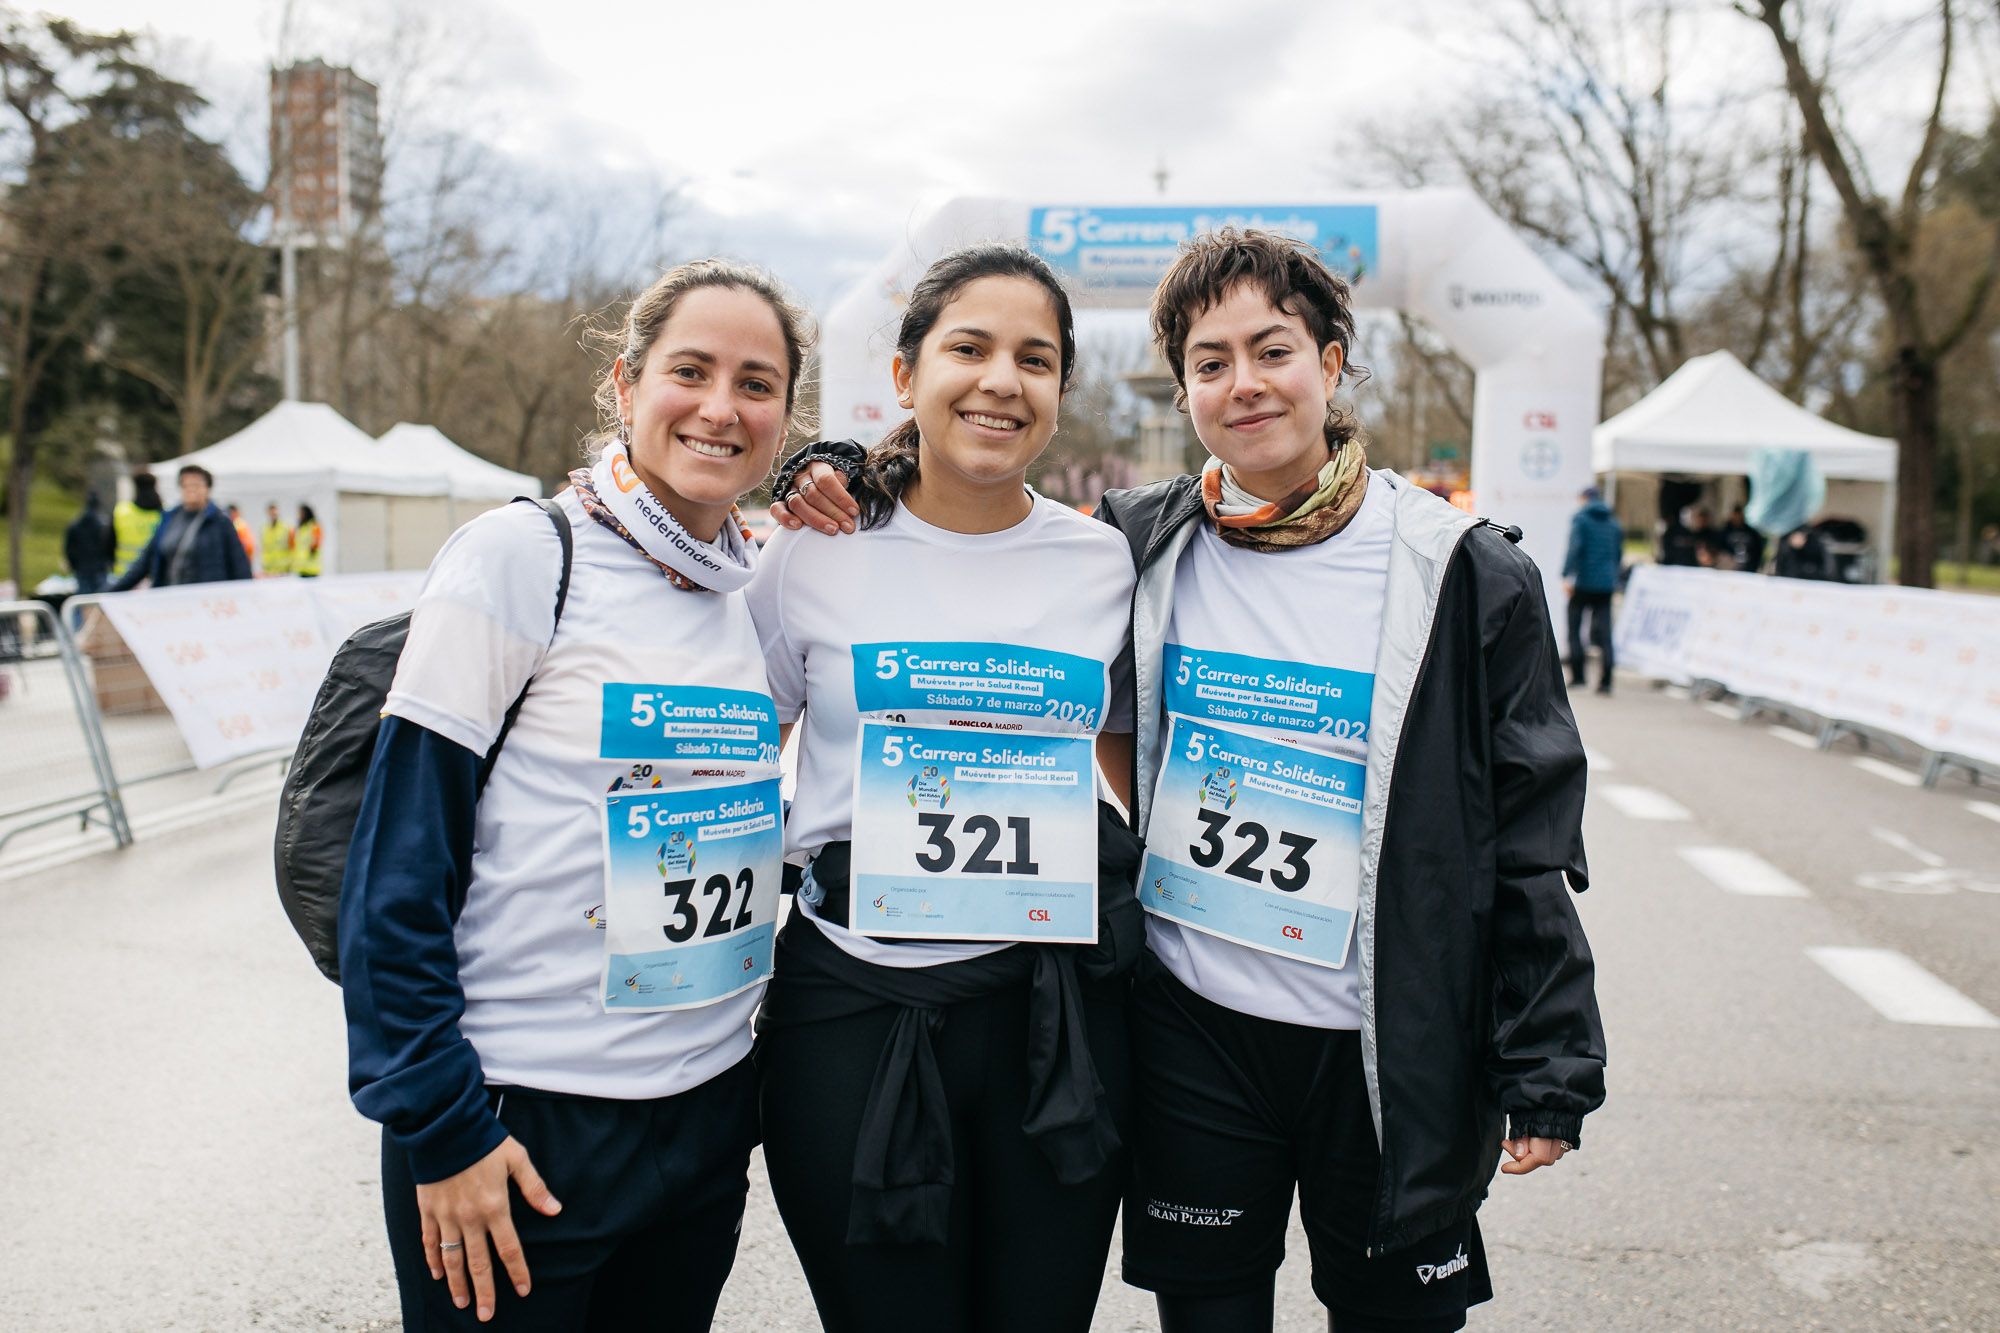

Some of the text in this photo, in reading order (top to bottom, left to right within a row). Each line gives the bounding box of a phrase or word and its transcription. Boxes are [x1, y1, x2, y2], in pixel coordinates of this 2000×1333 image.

[1077, 210, 1188, 242] Carrera
[635, 496, 722, 572] nederlanden
[905, 654, 980, 673] Carrera
[985, 657, 1066, 681] Solidaria
[917, 677, 1040, 692] Muévete por la Salud Renal
[1196, 664, 1260, 687] Carrera
[1263, 674, 1343, 699] Solidaria
[926, 693, 973, 707] Sábado
[976, 696, 984, 707] 7
[986, 696, 1001, 708] de
[1004, 700, 1042, 712] marzo
[1201, 687, 1313, 710] Muévete por la Salud Renal
[660, 700, 718, 719] Carrera
[719, 702, 769, 723] Solidaria
[1207, 704, 1371, 742] Sábado 7 de marzo 202
[670, 725, 755, 736] Muévete por la Salud Renal
[949, 719, 1023, 731] MONCLOA MADRID
[675, 742, 711, 755] Sábado
[711, 743, 719, 754] 7
[720, 744, 731, 755] de
[732, 746, 758, 757] marzo
[908, 743, 977, 763] Carrera
[981, 748, 1057, 767] Solidaria
[691, 769, 746, 778] MONCLOA MADRID
[960, 769, 1074, 782] Muévete por la Salud Renal
[1208, 743, 1268, 773] Carrera
[1271, 763, 1346, 792] Solidaria
[1249, 776, 1358, 811] Muévete por la Salud Renal
[655, 809, 716, 827] Carrera
[718, 797, 765, 820] Solidaria
[732, 826, 743, 835] por
[915, 812, 1039, 876] 321
[1189, 807, 1318, 893] 323
[662, 867, 754, 943] 322
[1028, 909, 1051, 922] CSL
[1282, 925, 1304, 941] CSL
[743, 956, 753, 971] CSL
[1147, 1204, 1177, 1221] GRAN
[1180, 1211, 1221, 1226] PLAZA
